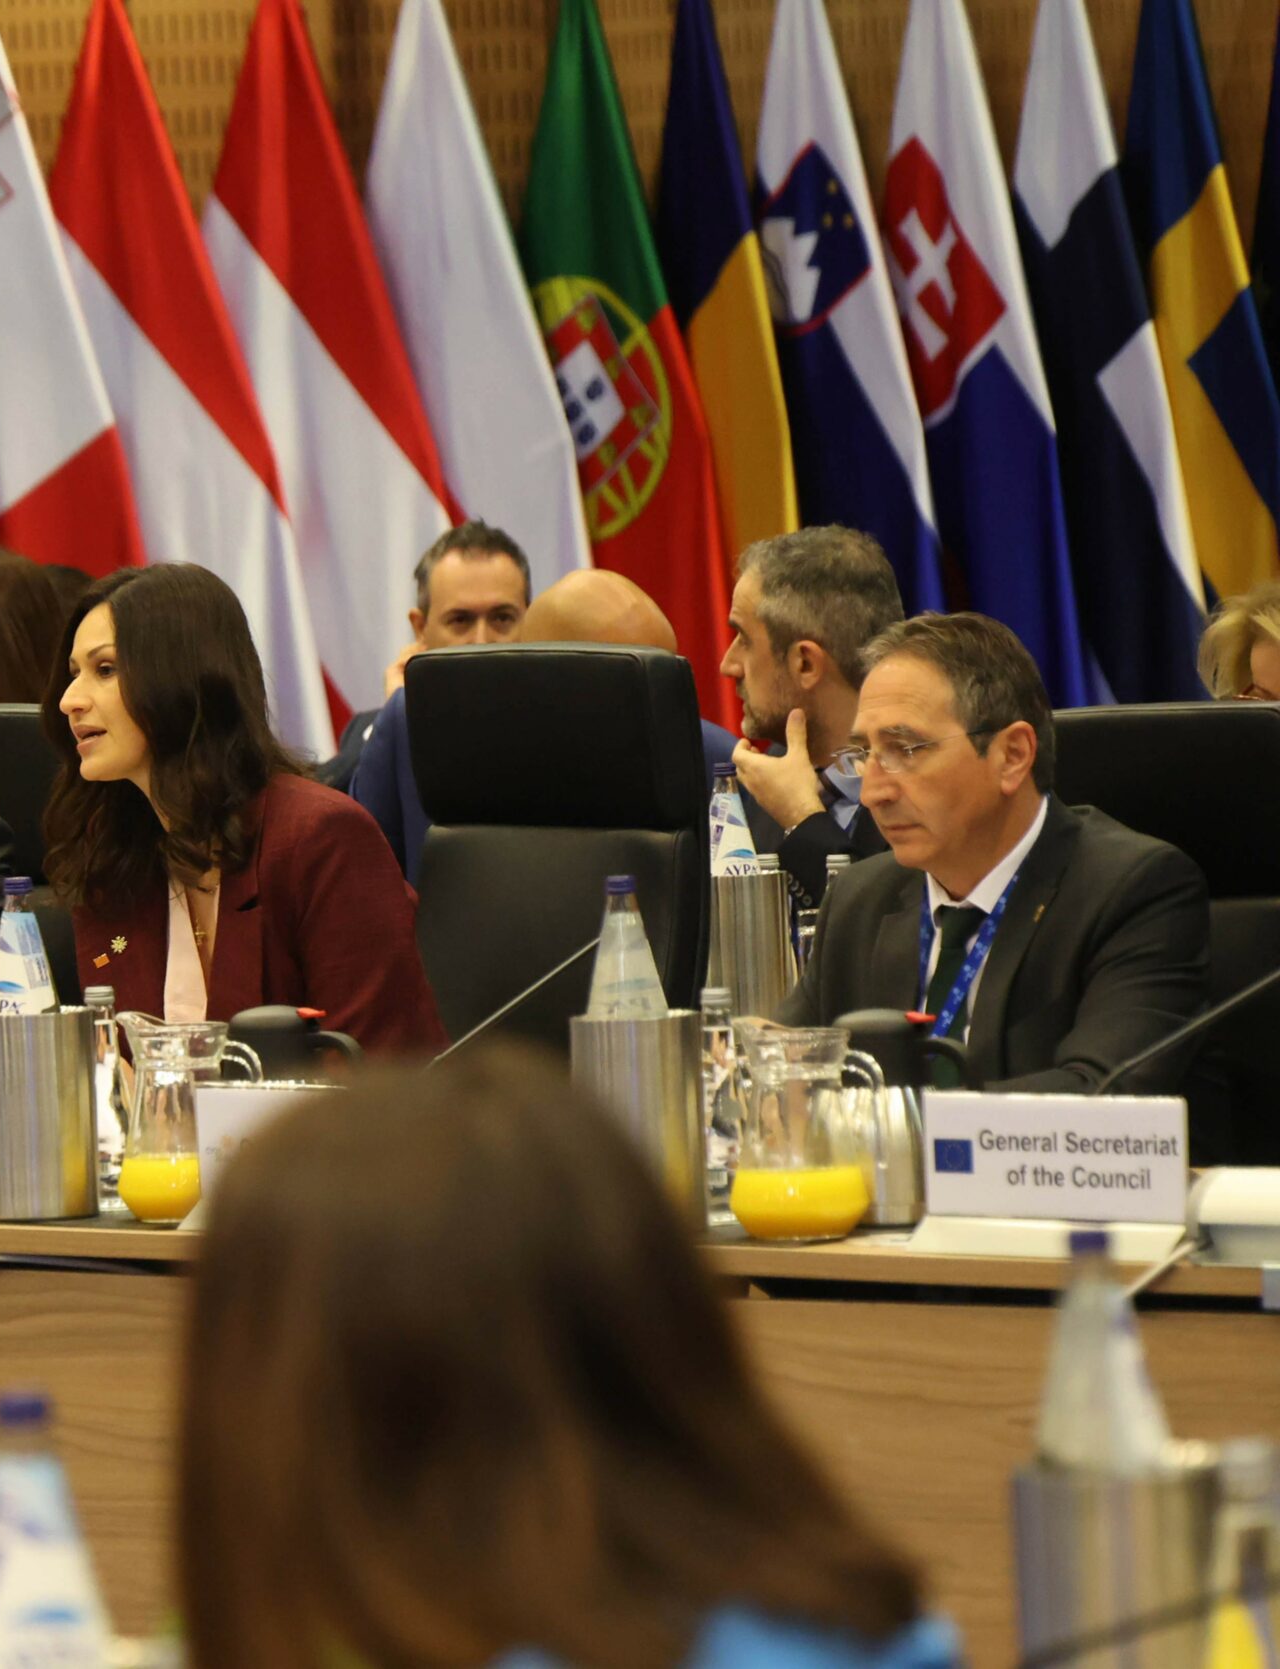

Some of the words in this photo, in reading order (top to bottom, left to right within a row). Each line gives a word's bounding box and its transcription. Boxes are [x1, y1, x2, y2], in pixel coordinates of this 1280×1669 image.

[979, 1129, 1059, 1152] General
[1065, 1132, 1180, 1157] Secretariat
[1007, 1164, 1028, 1186] of
[1033, 1165, 1065, 1188] the
[1071, 1166, 1152, 1190] Council
